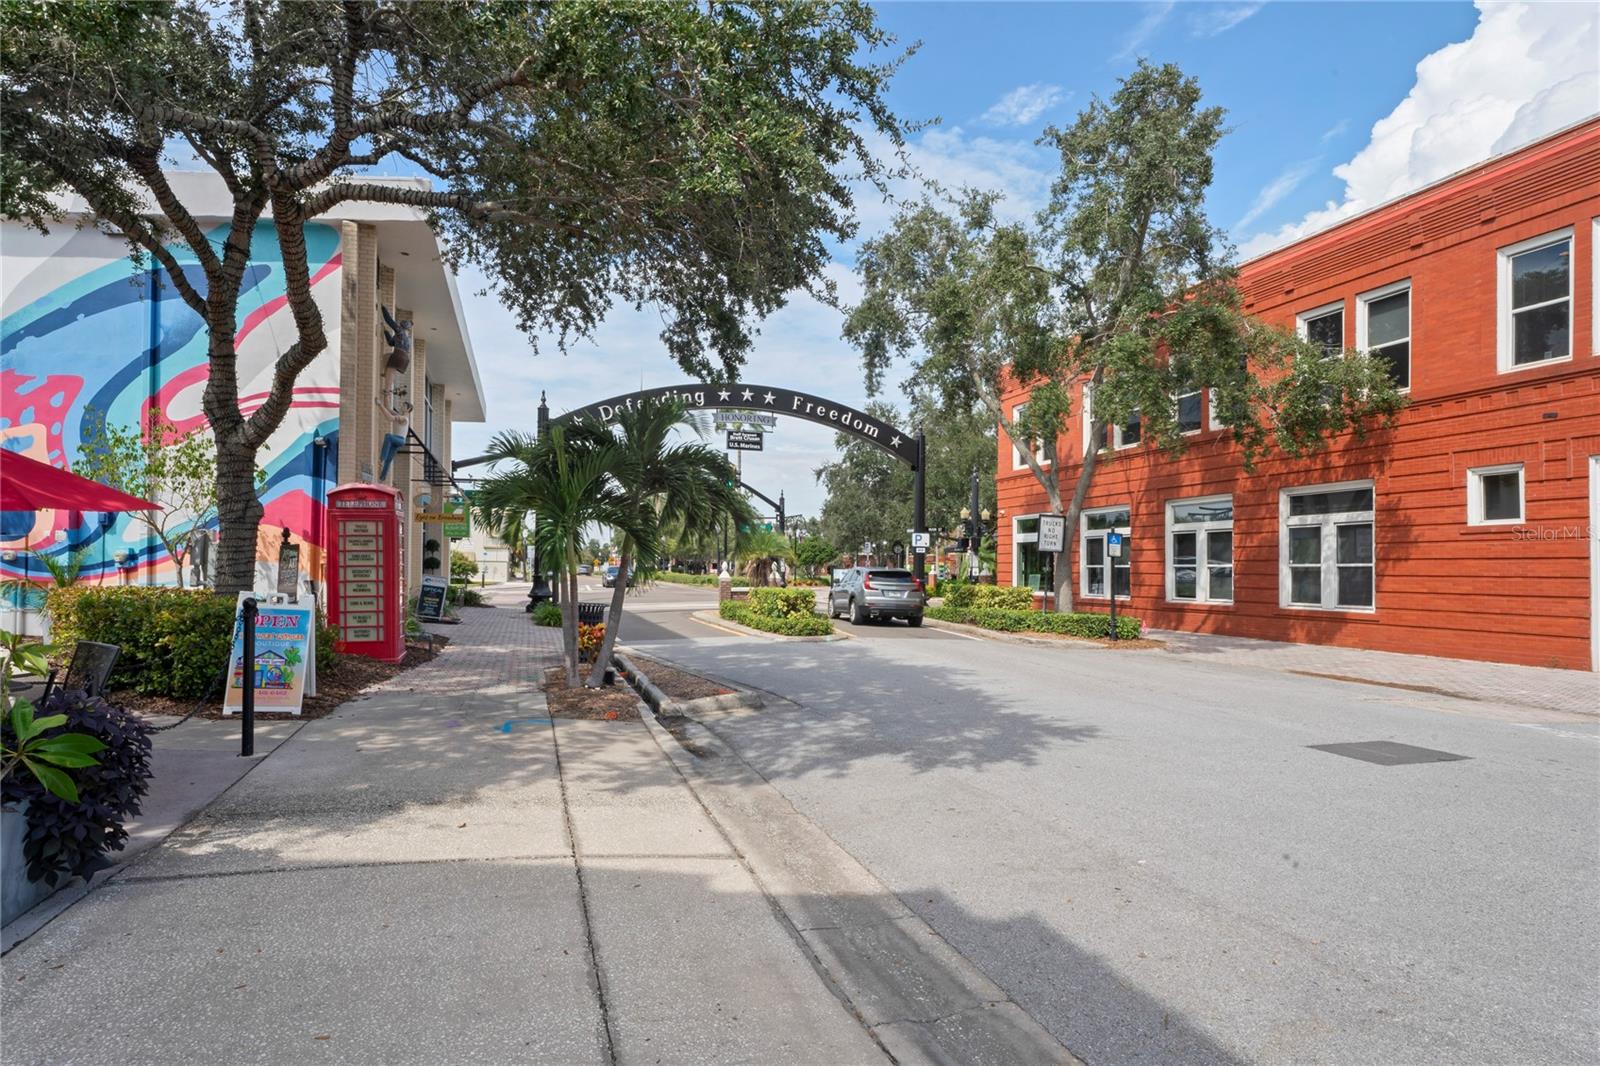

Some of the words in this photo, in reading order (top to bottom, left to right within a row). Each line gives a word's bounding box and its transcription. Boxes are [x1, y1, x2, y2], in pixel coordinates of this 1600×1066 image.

[721, 413, 770, 425] HONORING
[792, 396, 879, 437] Freedom
[1043, 519, 1062, 527] TRUCKS
[915, 534, 922, 545] P
